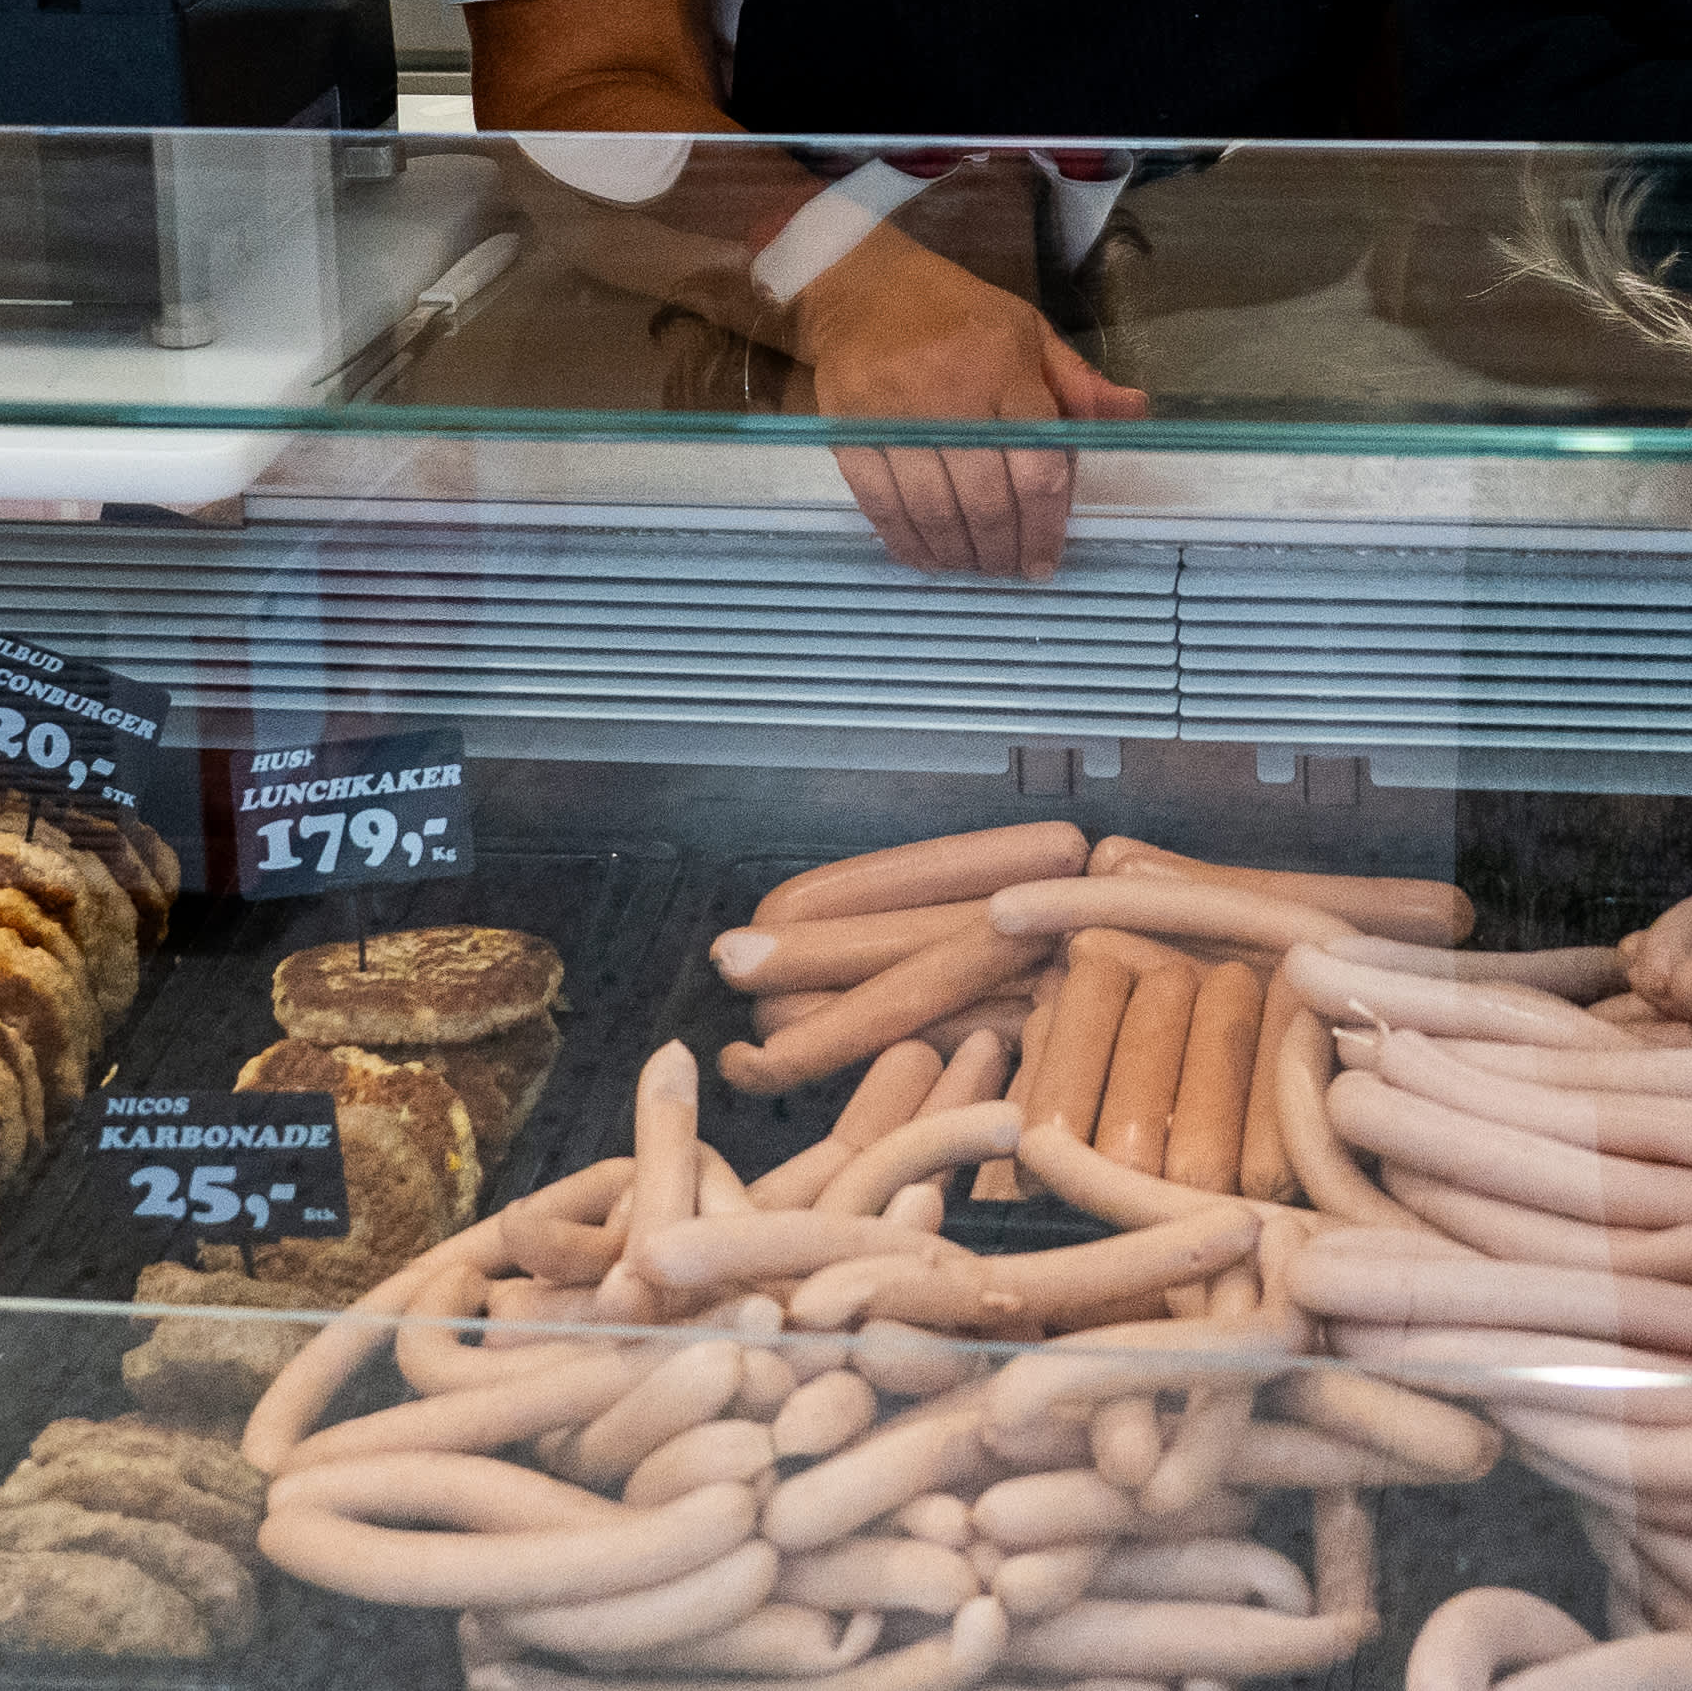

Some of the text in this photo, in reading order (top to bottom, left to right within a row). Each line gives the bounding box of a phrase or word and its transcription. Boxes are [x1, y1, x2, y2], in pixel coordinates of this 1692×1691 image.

[101, 786, 137, 808] STK
[239, 764, 462, 811] LUNCHKAKER
[257, 808, 448, 873] 179,-
[106, 1097, 190, 1116] NICOS
[99, 1124, 332, 1150] KARBONADE
[129, 1165, 297, 1230] 25,-
